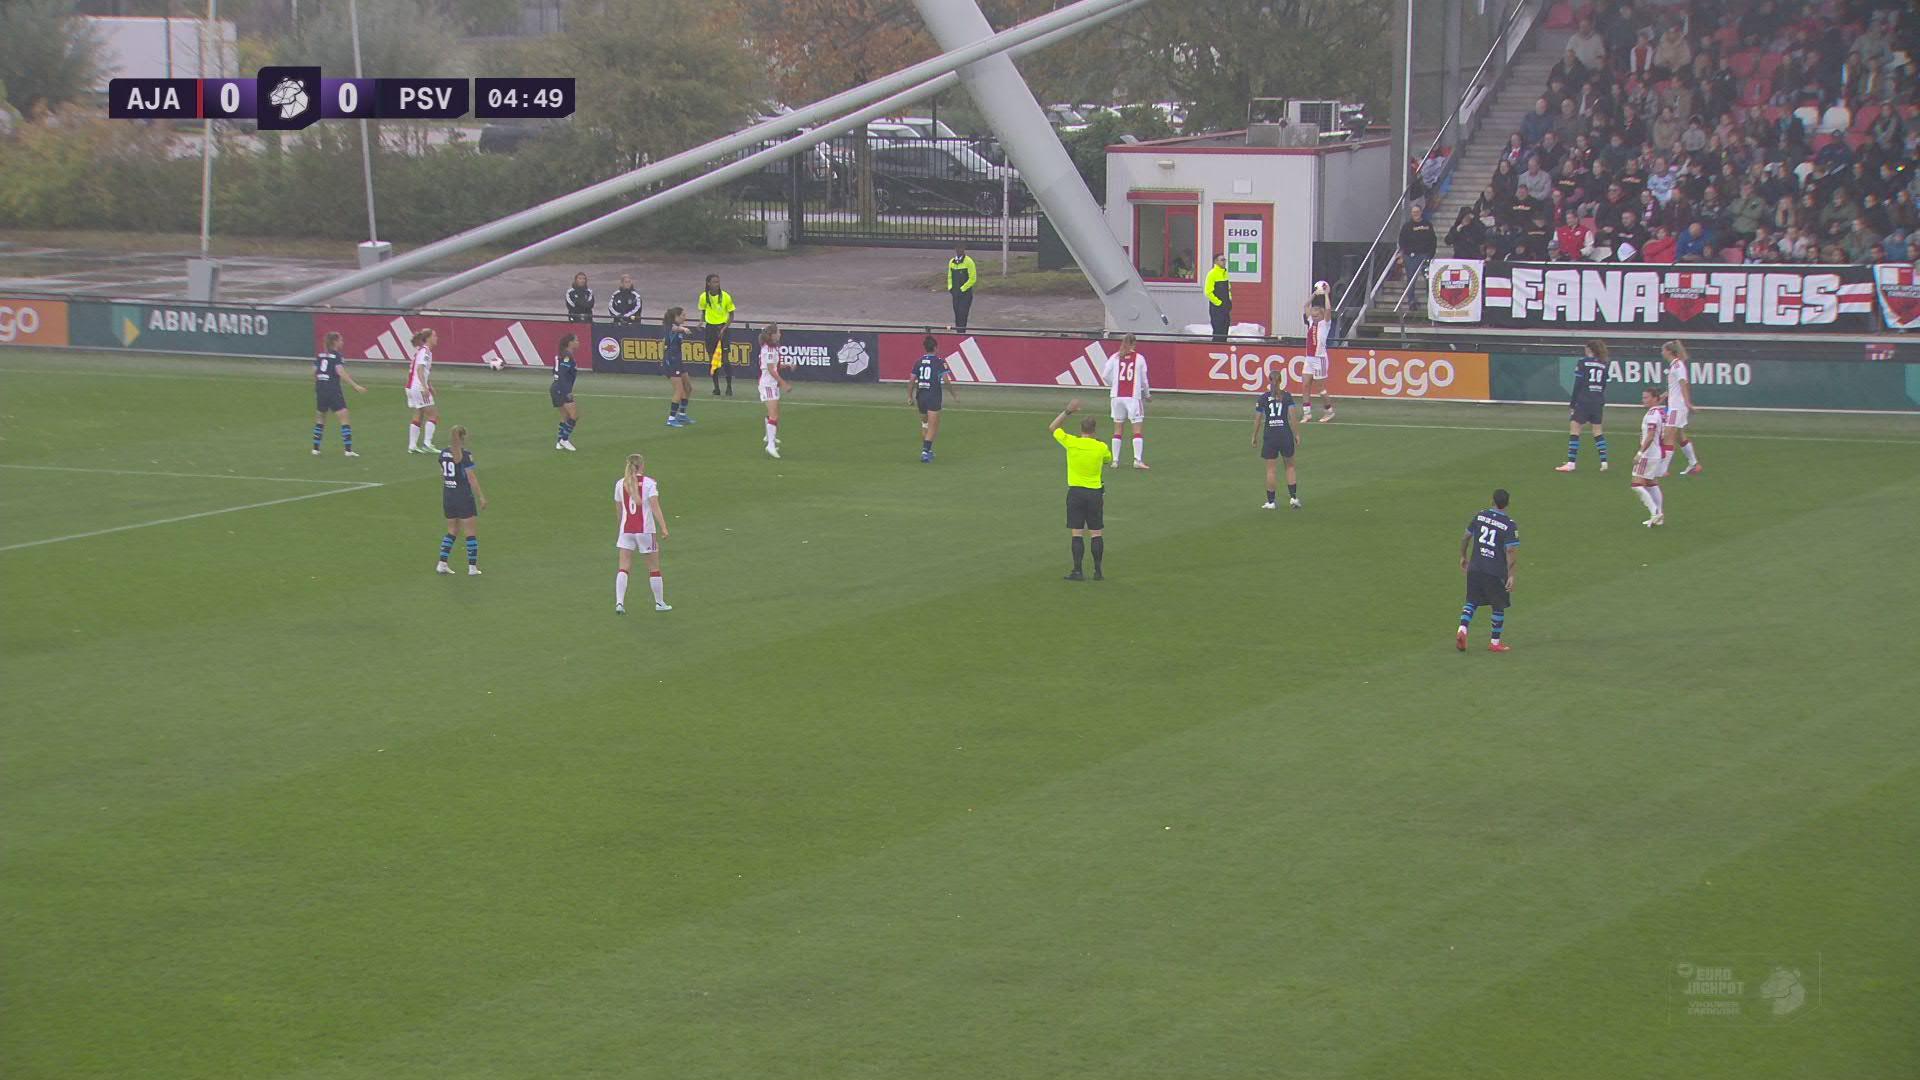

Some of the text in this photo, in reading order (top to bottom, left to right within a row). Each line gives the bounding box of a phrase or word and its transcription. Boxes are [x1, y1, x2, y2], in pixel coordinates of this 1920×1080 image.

[1228, 228, 1258, 237] EHBO
[777, 345, 828, 356] OUWEN
[919, 366, 931, 380] 10
[1119, 361, 1134, 381] 26
[1346, 350, 1454, 396] ziggo
[1268, 402, 1282, 417] 17
[442, 461, 456, 477] 19
[1478, 525, 1497, 547] 21
